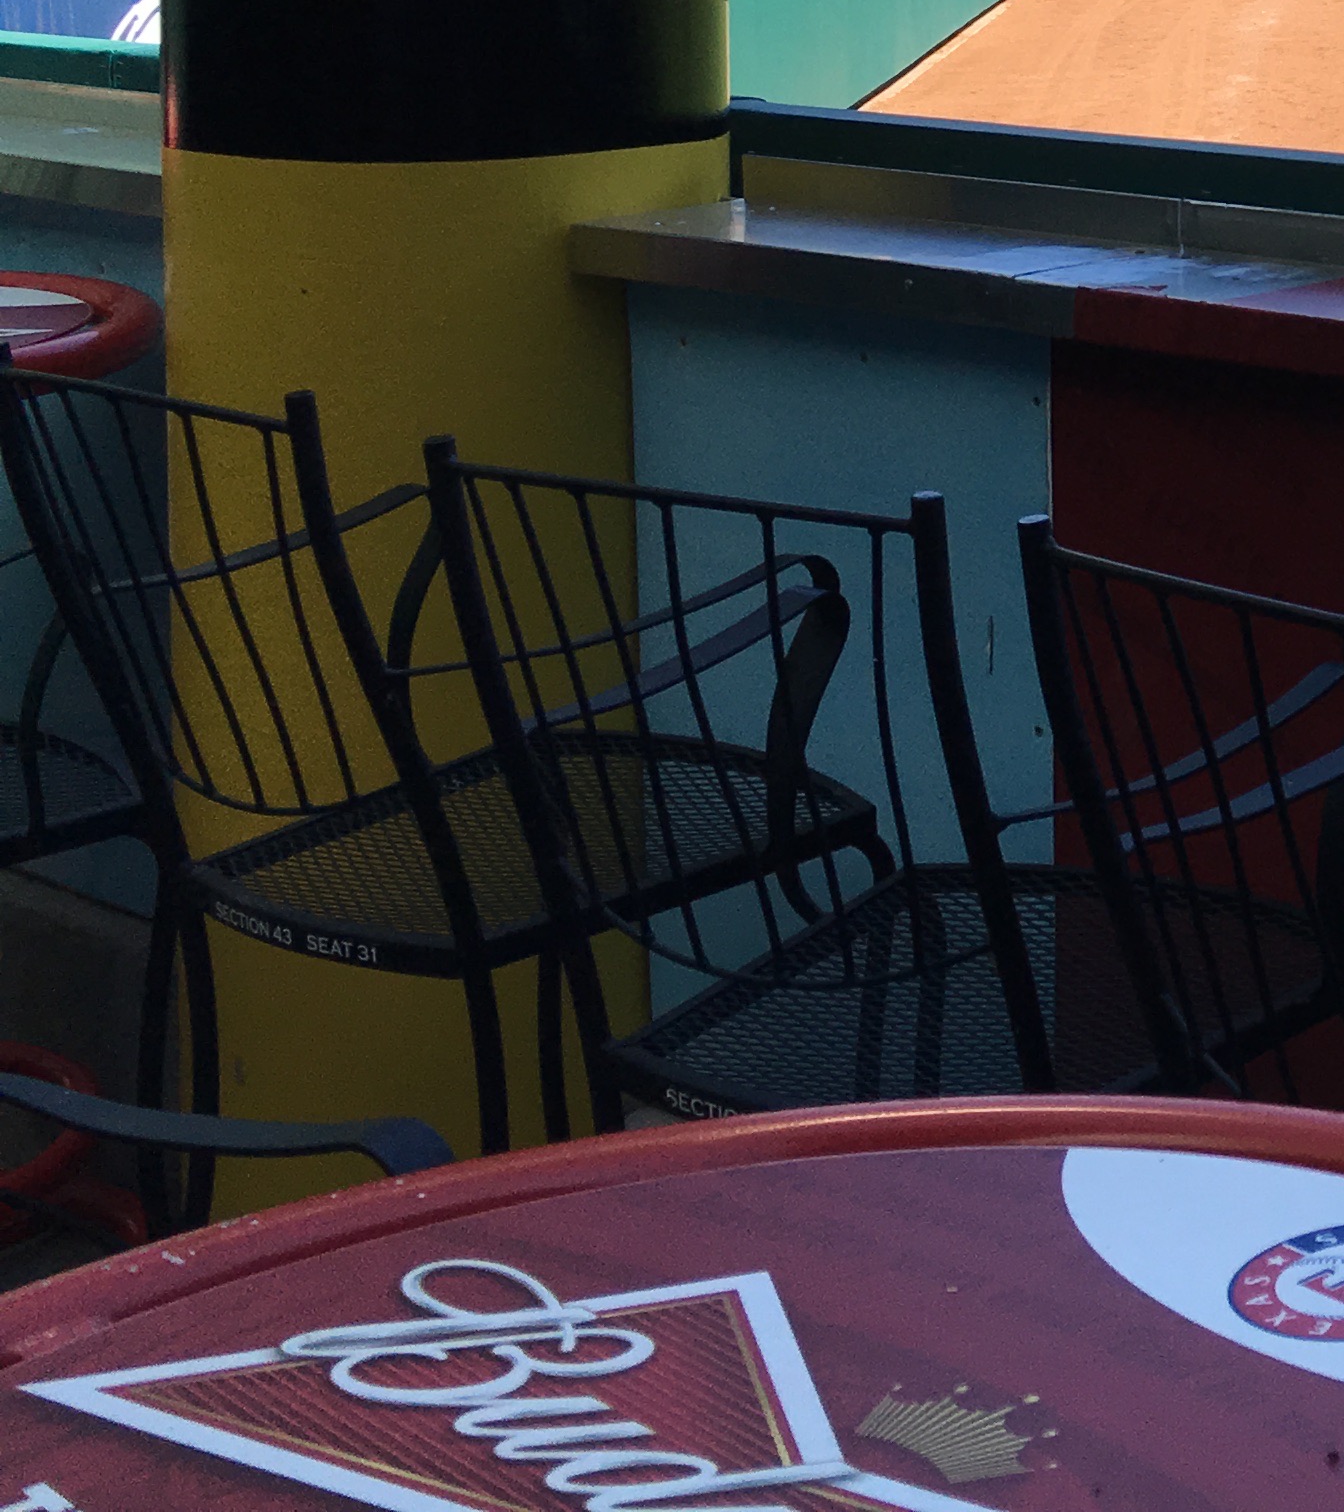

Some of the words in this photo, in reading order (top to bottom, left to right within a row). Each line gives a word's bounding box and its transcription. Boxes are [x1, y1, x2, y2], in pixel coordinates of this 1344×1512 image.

[215, 900, 270, 939] SECTION
[272, 925, 293, 946] 43
[306, 934, 353, 959] SEAT
[356, 944, 378, 963] 31
[280, 1258, 858, 1510] Bud
